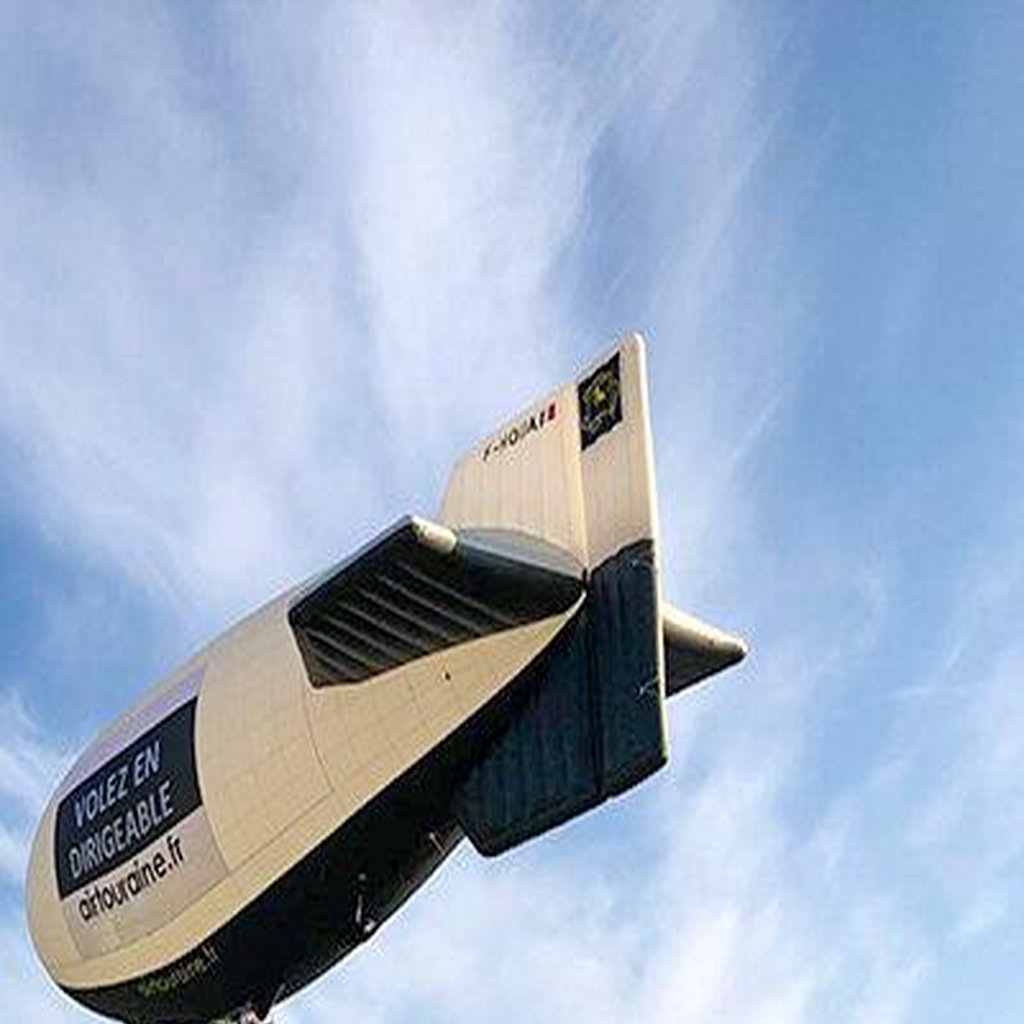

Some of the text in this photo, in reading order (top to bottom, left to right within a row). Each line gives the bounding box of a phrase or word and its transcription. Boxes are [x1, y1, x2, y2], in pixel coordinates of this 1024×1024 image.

[74, 740, 162, 827] VOLEZ EN
[67, 779, 174, 880] DIRIGEABLE
[78, 835, 185, 921] airtouraine.fr
